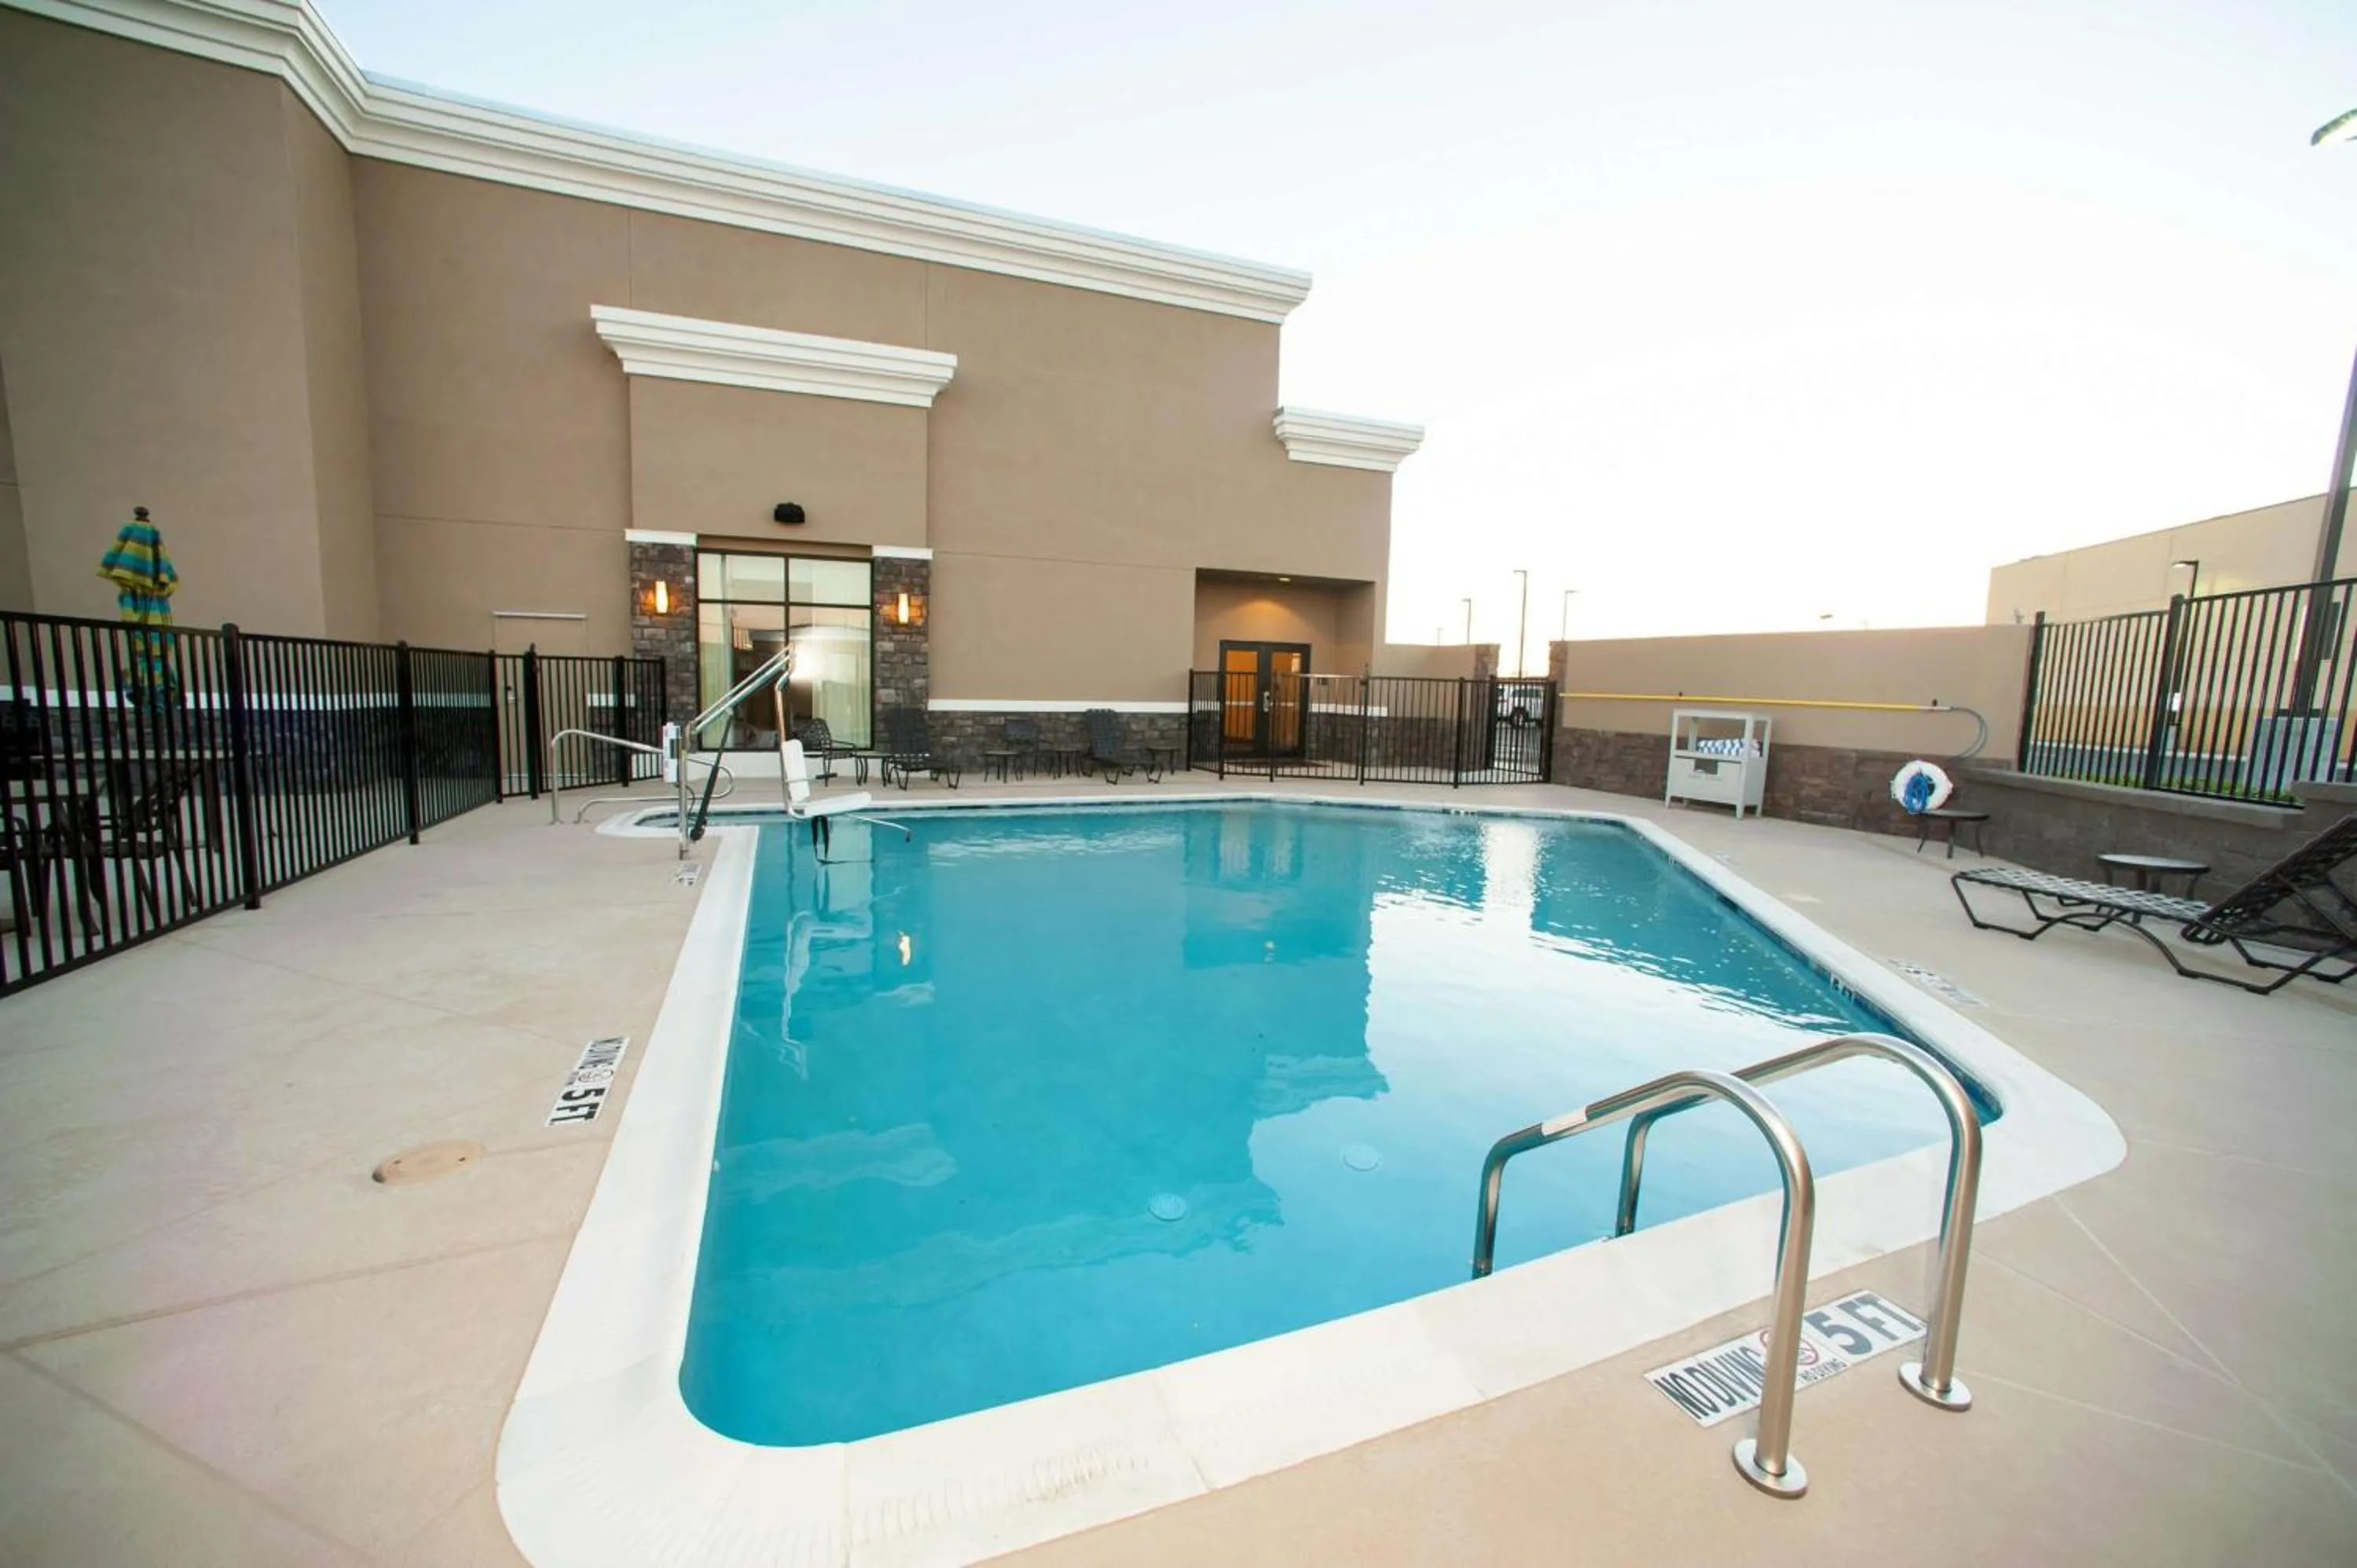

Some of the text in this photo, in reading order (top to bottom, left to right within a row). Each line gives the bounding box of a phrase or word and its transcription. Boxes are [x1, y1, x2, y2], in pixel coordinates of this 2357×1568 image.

[1803, 1293, 1922, 1355] 5 FT
[1654, 1372, 1721, 1420] NO
